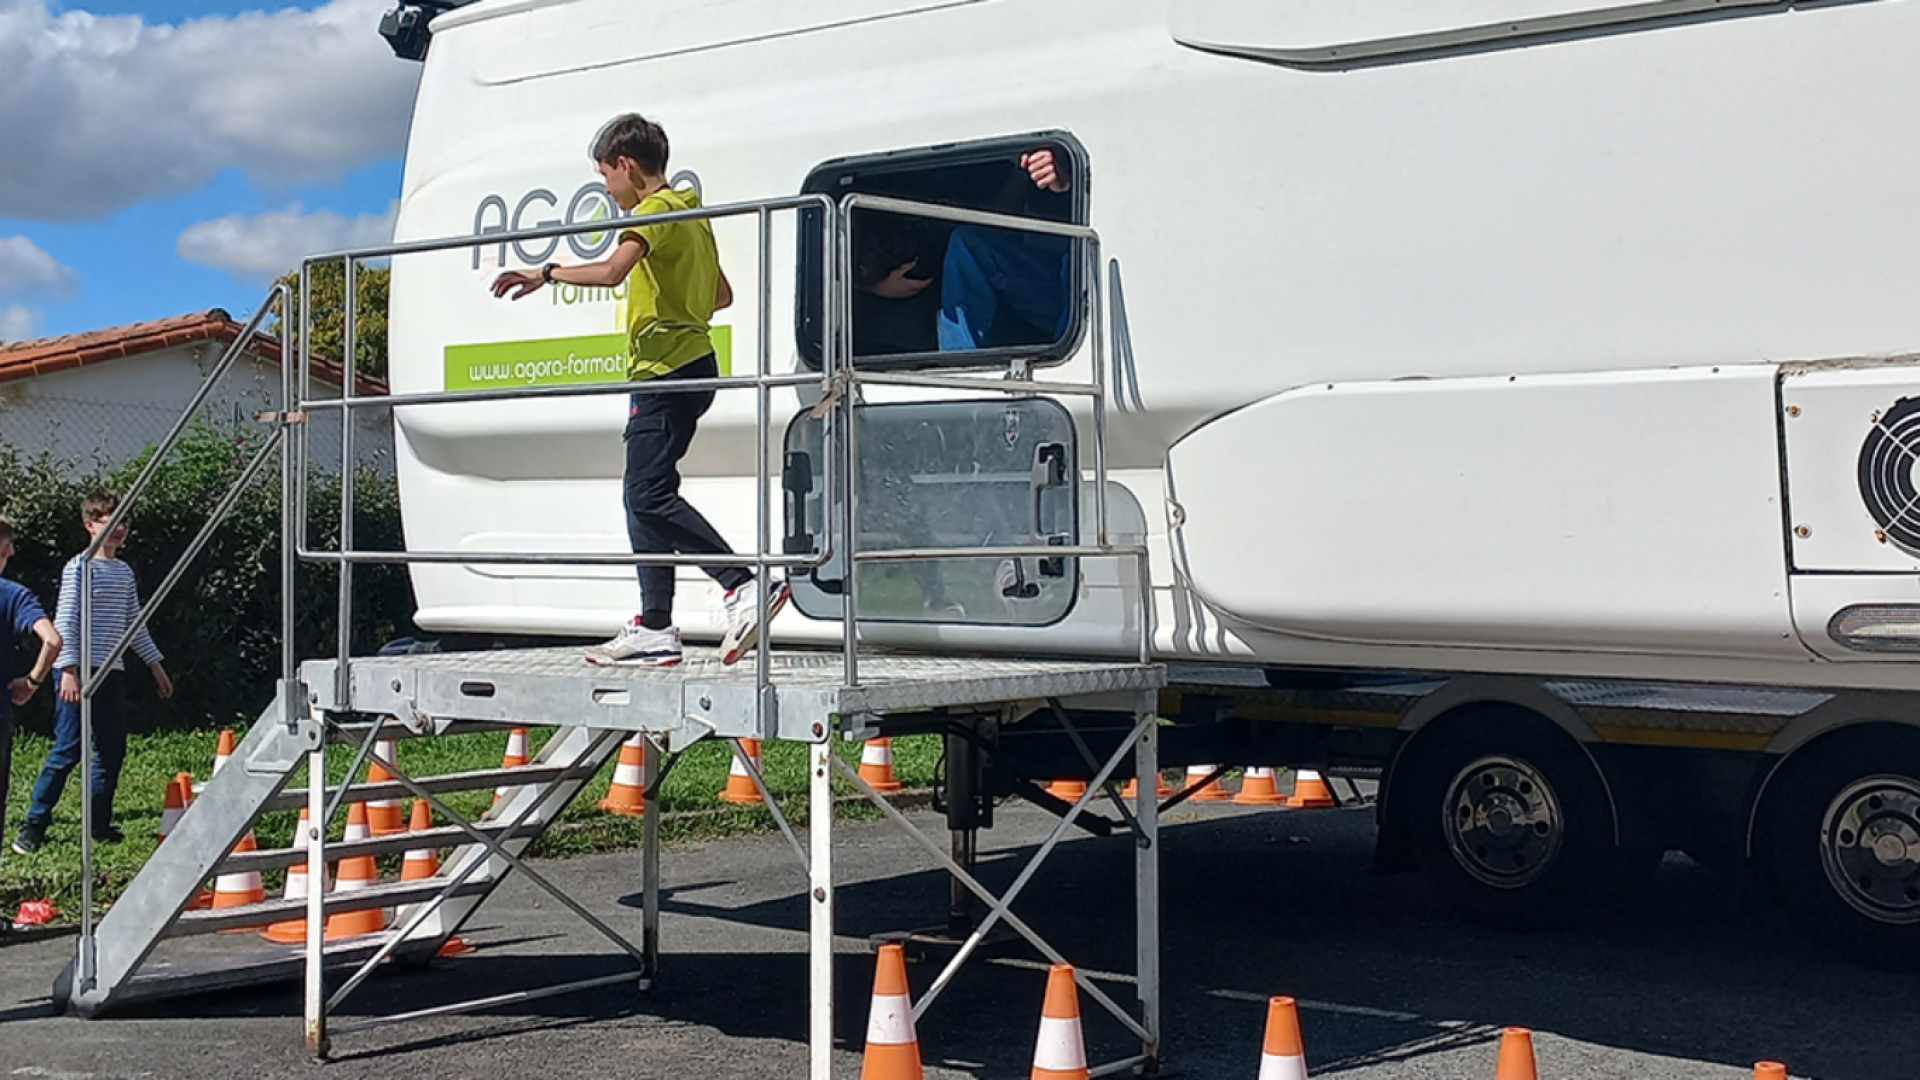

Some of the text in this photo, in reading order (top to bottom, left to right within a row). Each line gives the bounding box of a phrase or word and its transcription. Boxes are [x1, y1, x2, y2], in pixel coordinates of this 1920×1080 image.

[472, 170, 702, 269] AGO
[552, 281, 628, 305] forma
[469, 352, 627, 384] www.agora-formati
